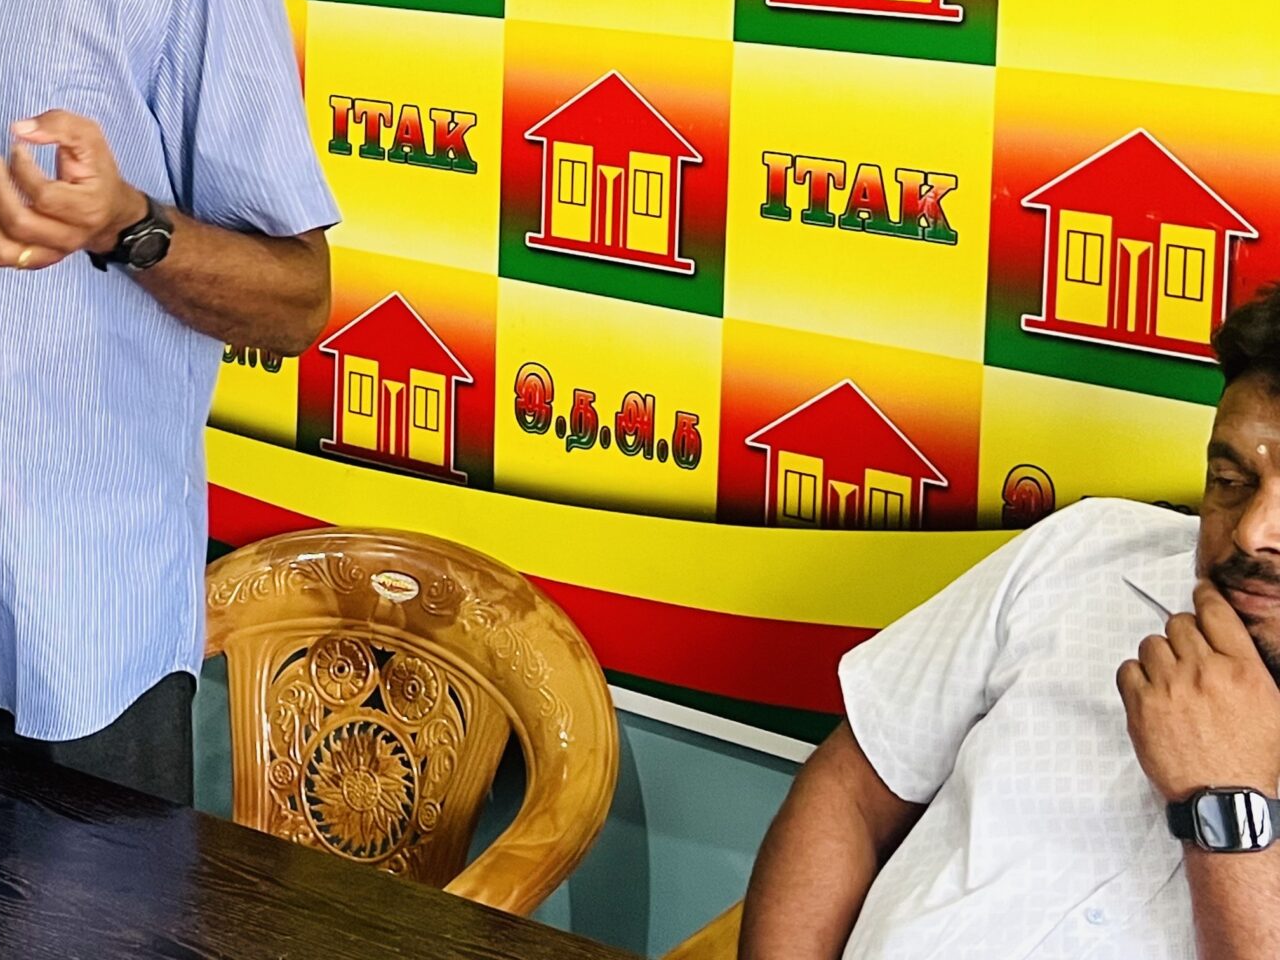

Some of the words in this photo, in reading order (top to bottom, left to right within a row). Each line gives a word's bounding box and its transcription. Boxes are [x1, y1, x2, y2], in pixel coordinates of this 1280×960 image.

[328, 95, 478, 174] ITAK
[760, 152, 958, 245] ITAK
[514, 362, 702, 471] இ.த.அ.க
